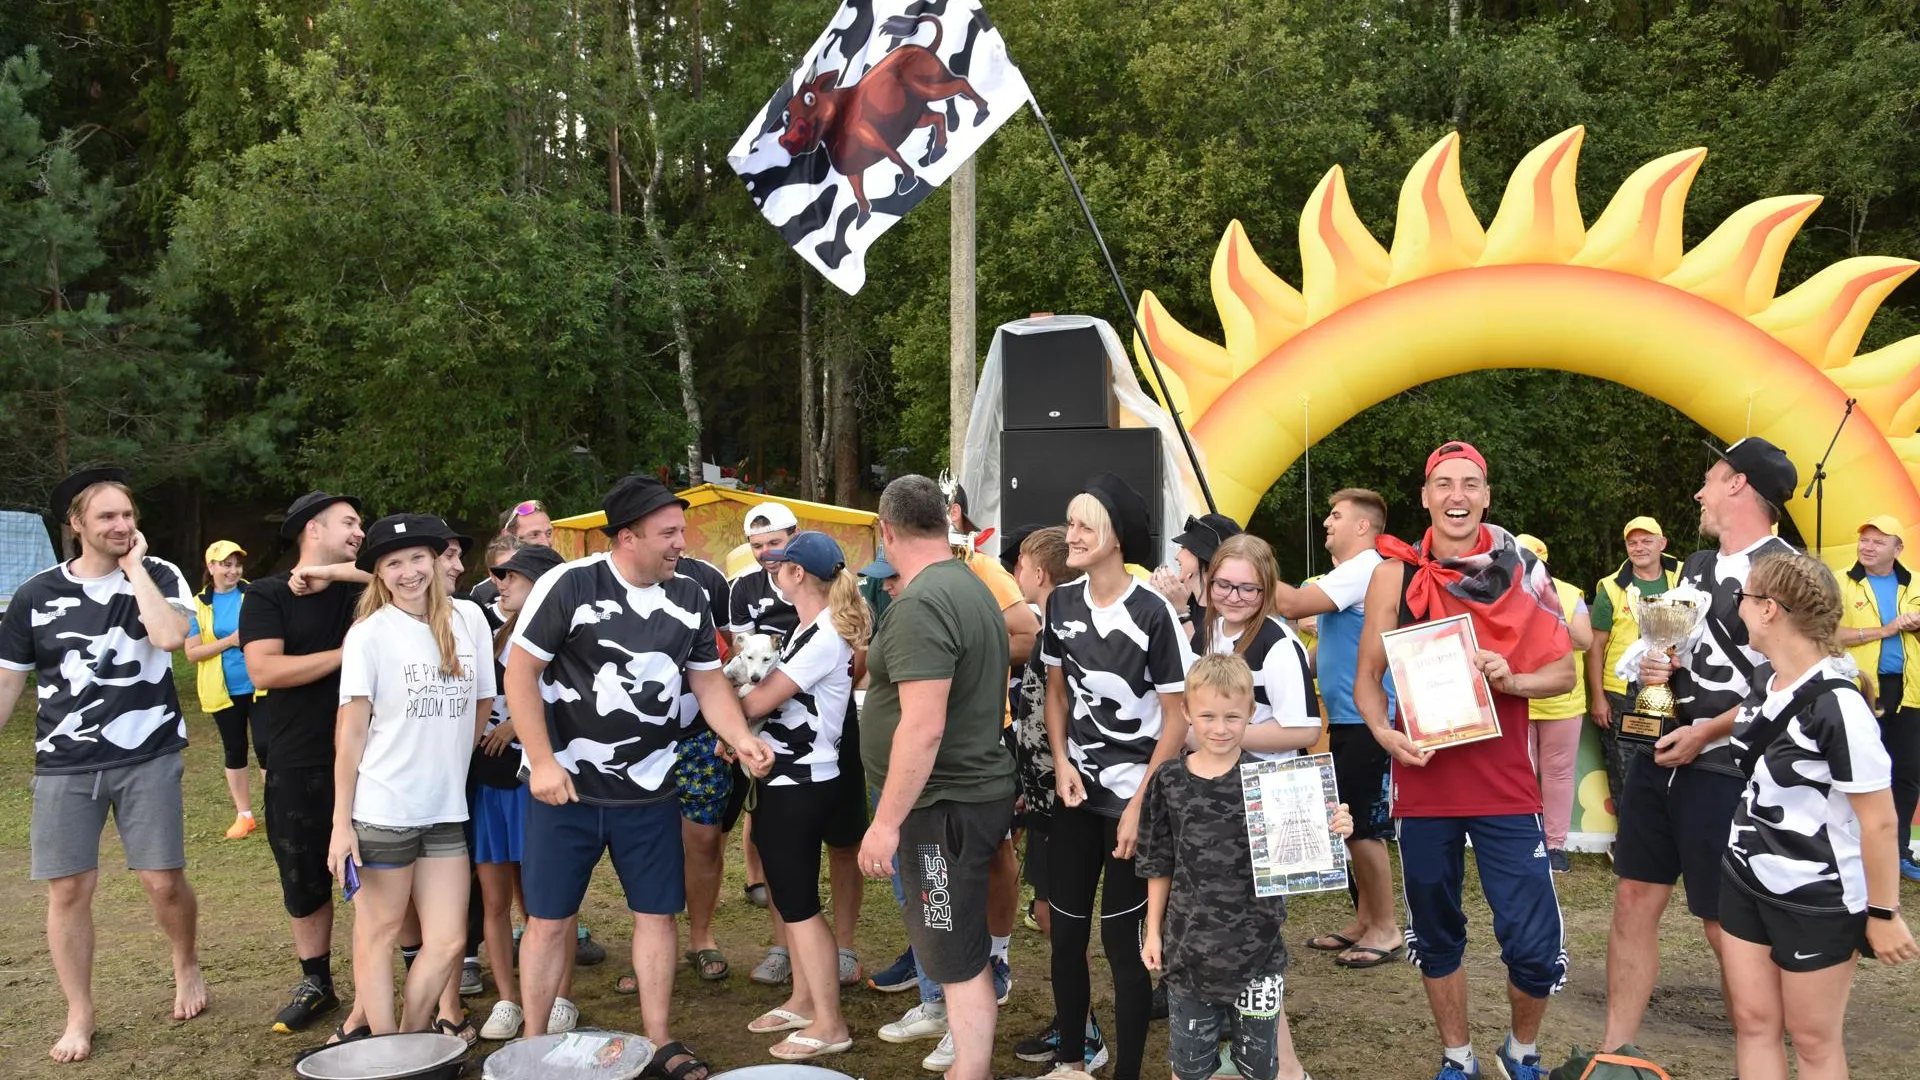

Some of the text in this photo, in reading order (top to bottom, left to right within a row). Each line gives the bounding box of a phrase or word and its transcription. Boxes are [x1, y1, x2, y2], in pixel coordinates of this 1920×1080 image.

[404, 664, 420, 684] НЕ
[408, 685, 472, 696] МАТОМ
[406, 698, 443, 719] РЯДОМ
[924, 854, 953, 932] SPORT
[923, 903, 932, 928] ACTIVE
[1237, 986, 1283, 1011] BES
